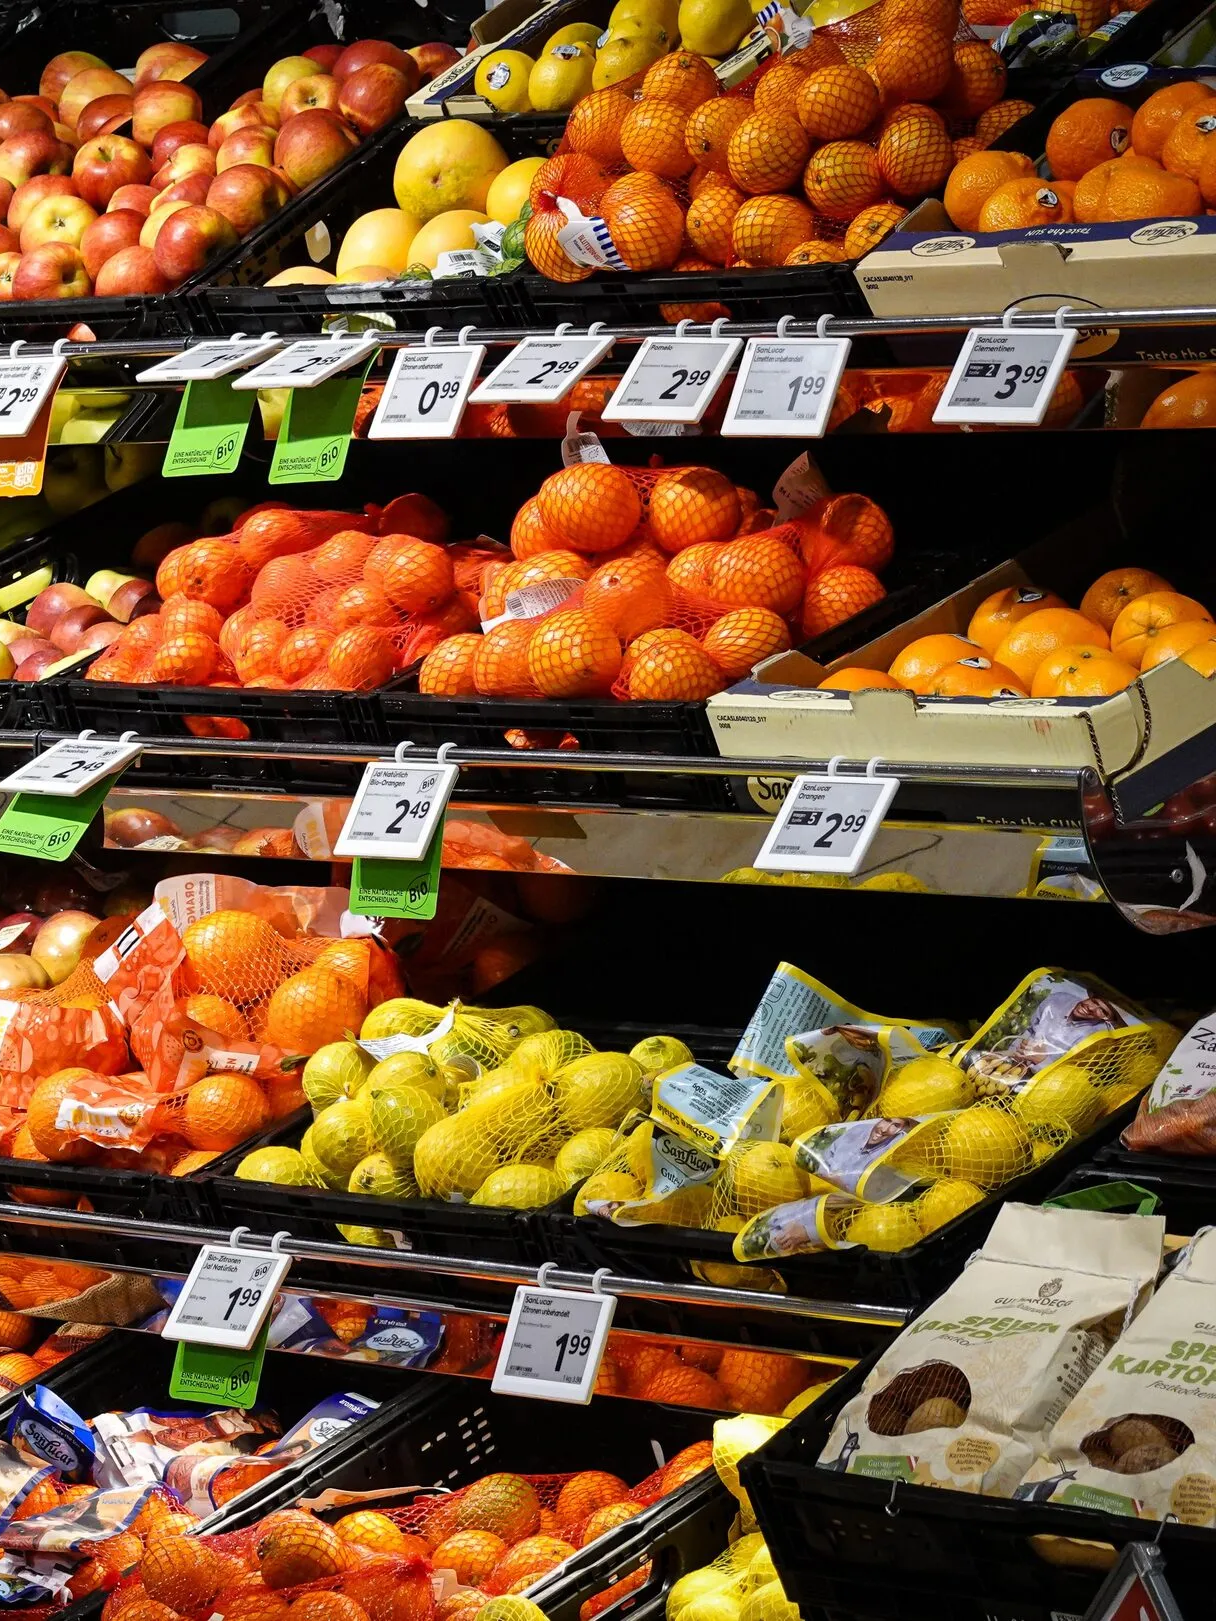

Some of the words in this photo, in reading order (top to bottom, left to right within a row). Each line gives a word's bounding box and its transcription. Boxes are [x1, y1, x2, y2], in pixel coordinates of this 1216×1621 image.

[756, 346, 785, 354] SanLucar
[974, 345, 1015, 353] Clementinen
[985, 364, 995, 376] 2
[383, 771, 409, 779] Natürlich
[370, 779, 406, 788] Bio-Orangen
[802, 784, 833, 792] SanLucar
[798, 792, 826, 801] Orangen
[807, 812, 817, 824] 5
[358, 895, 399, 904] ENTSCHEIDUNG
[691, 1082, 708, 1096] 500g
[662, 1138, 714, 1173] SanLucar
[207, 1253, 242, 1264] Bio-Zitronen
[212, 1263, 238, 1273] Natürlich
[525, 1295, 554, 1306] SanLucar
[522, 1306, 542, 1316] Zitronen
[542, 1308, 571, 1318] unbehandelt
[179, 1379, 220, 1391] ENTSCHEIDUNG
[24, 1422, 75, 1467] SanLucar
